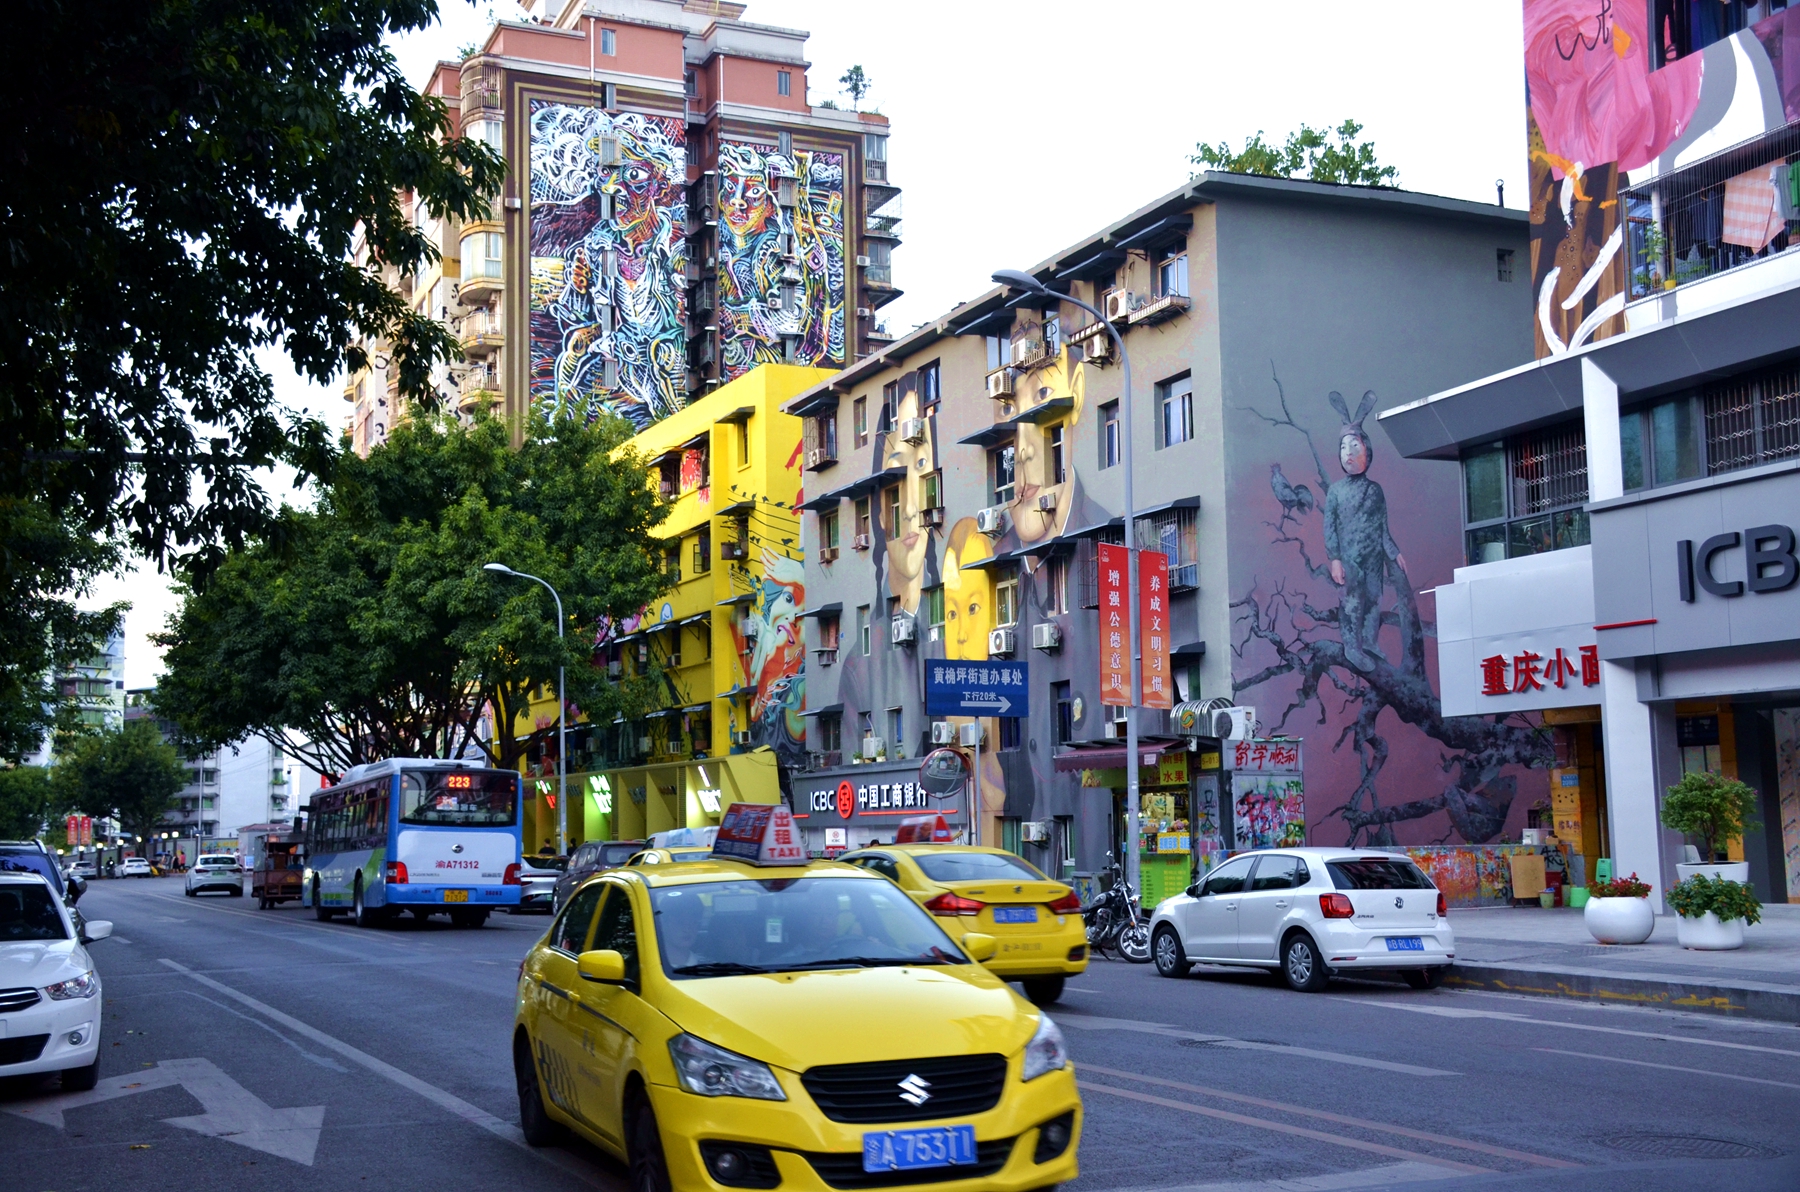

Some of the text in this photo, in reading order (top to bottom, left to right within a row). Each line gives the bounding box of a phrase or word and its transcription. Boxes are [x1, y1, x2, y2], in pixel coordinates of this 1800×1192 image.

[1107, 568, 1122, 690] 增强公德意识
[1149, 575, 1163, 693] 养成文明习惯
[933, 666, 1023, 686] 黄桷坪街道办事处
[962, 691, 997, 702] 下行20米
[1235, 740, 1299, 771] 留学顺利
[448, 776, 471, 788] 223
[1163, 770, 1185, 783] 水果
[810, 790, 835, 811] ICBC
[858, 781, 927, 809] 中国工商银行
[774, 811, 793, 845] 出租
[767, 846, 801, 858] TAXI
[435, 860, 480, 870] 渝A71312
[445, 894, 468, 902] 71312
